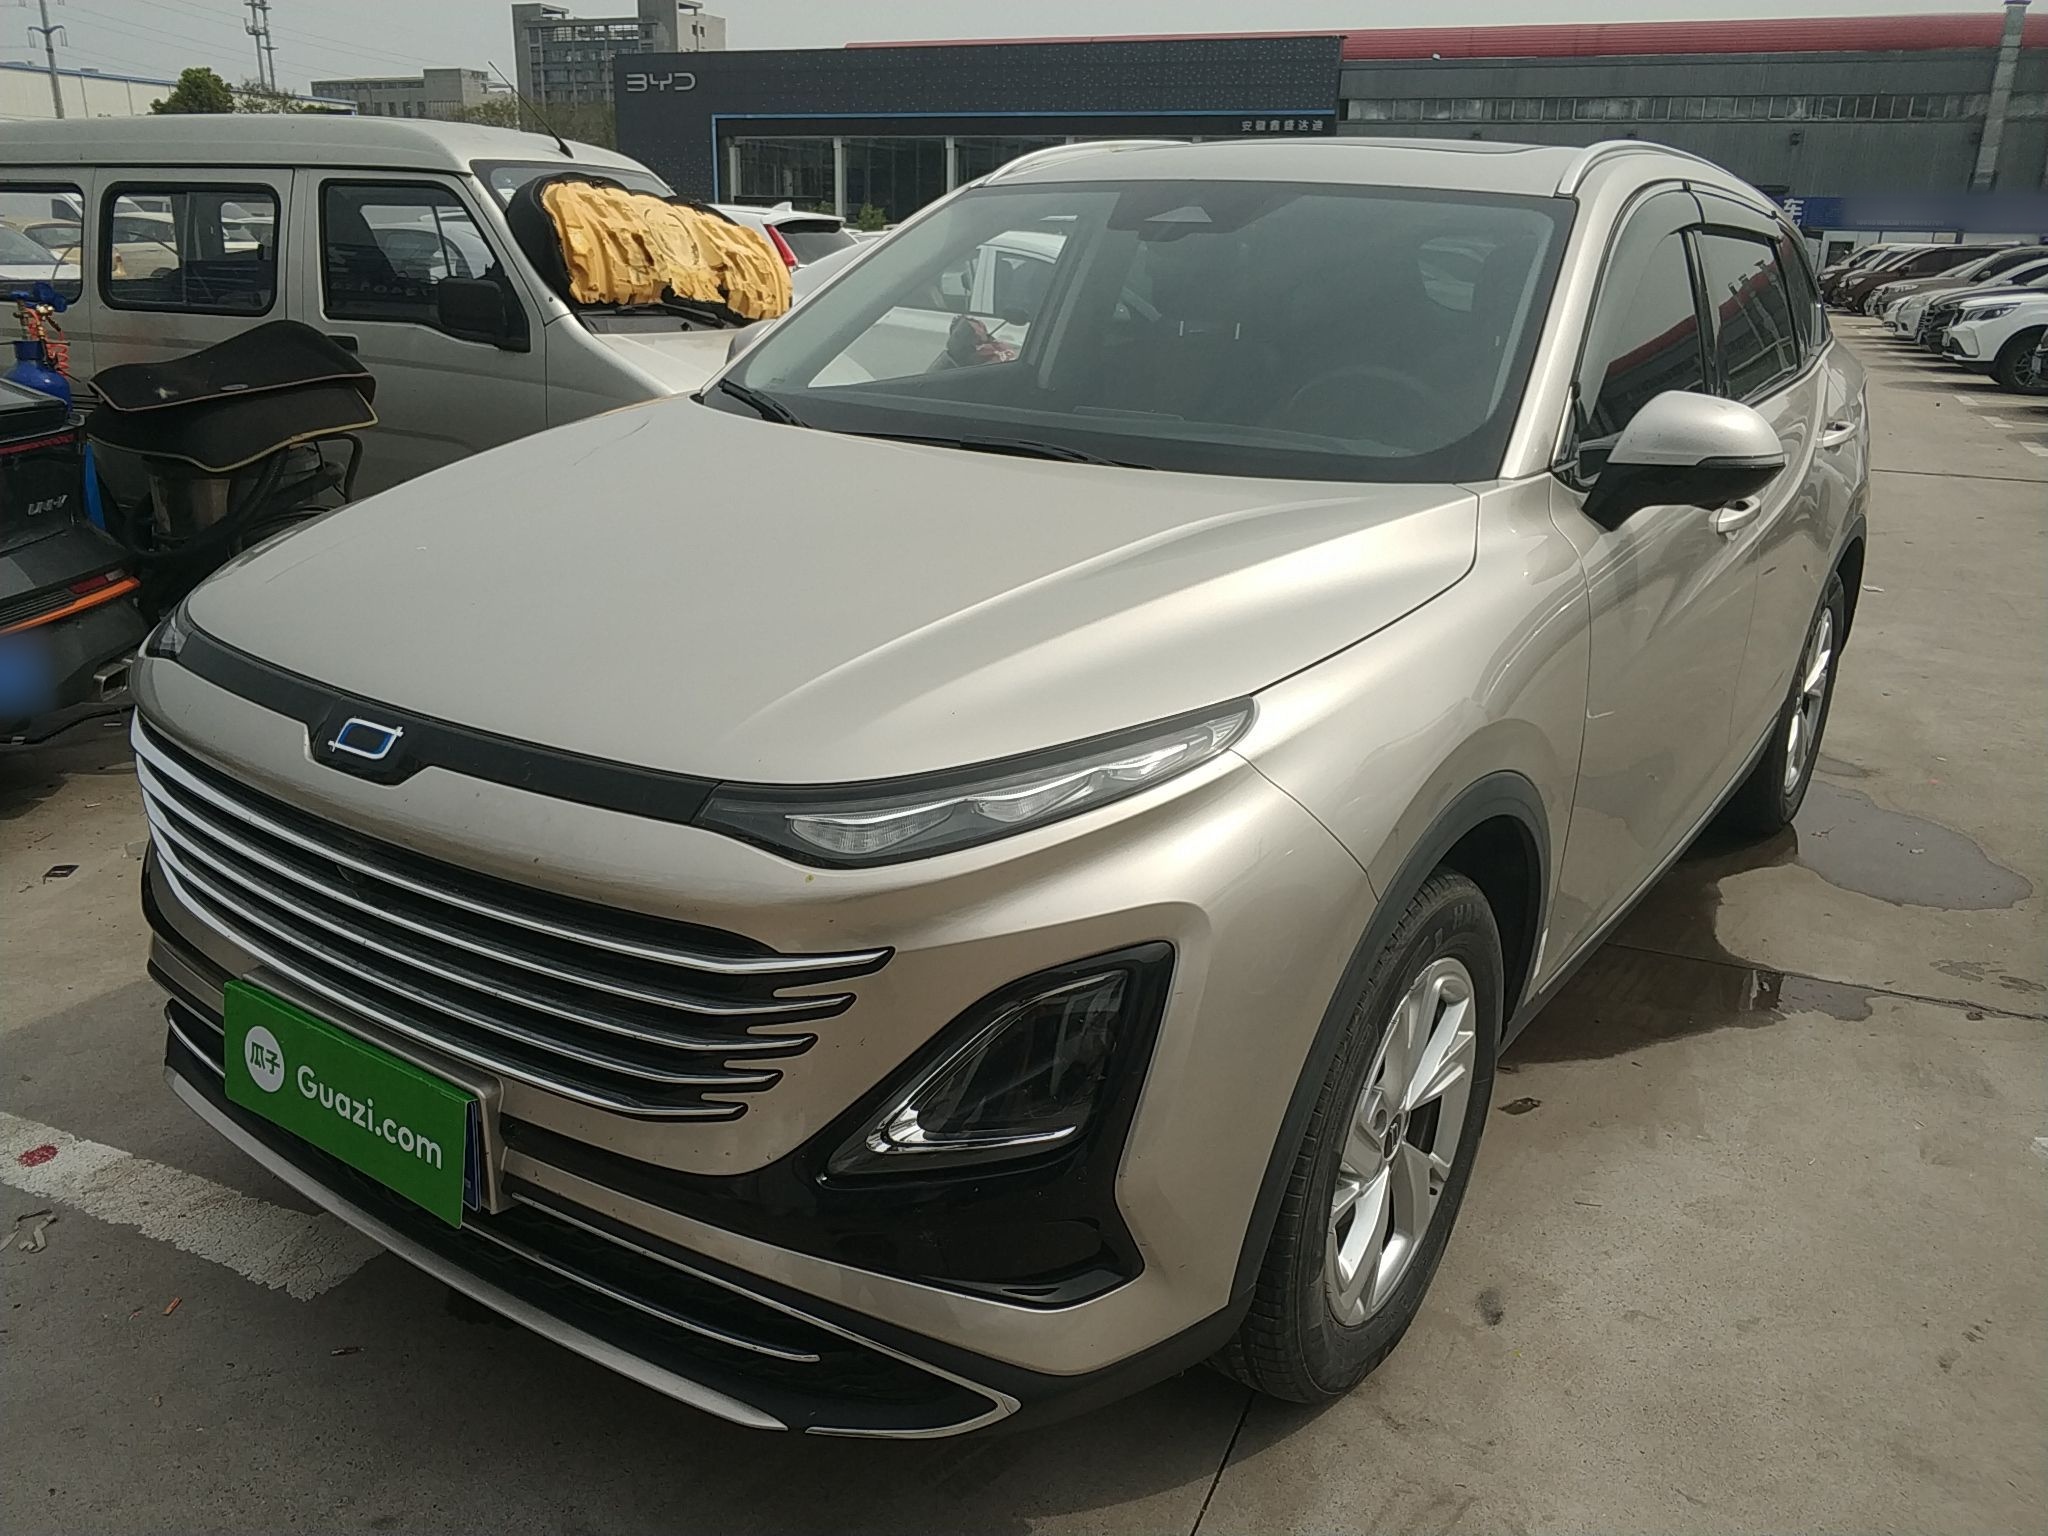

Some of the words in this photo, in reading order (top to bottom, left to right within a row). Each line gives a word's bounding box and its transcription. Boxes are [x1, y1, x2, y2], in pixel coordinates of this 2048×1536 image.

[627, 72, 696, 92] BYD
[250, 1042, 281, 1075] 瓜子
[297, 1065, 443, 1170] Guazi.com
